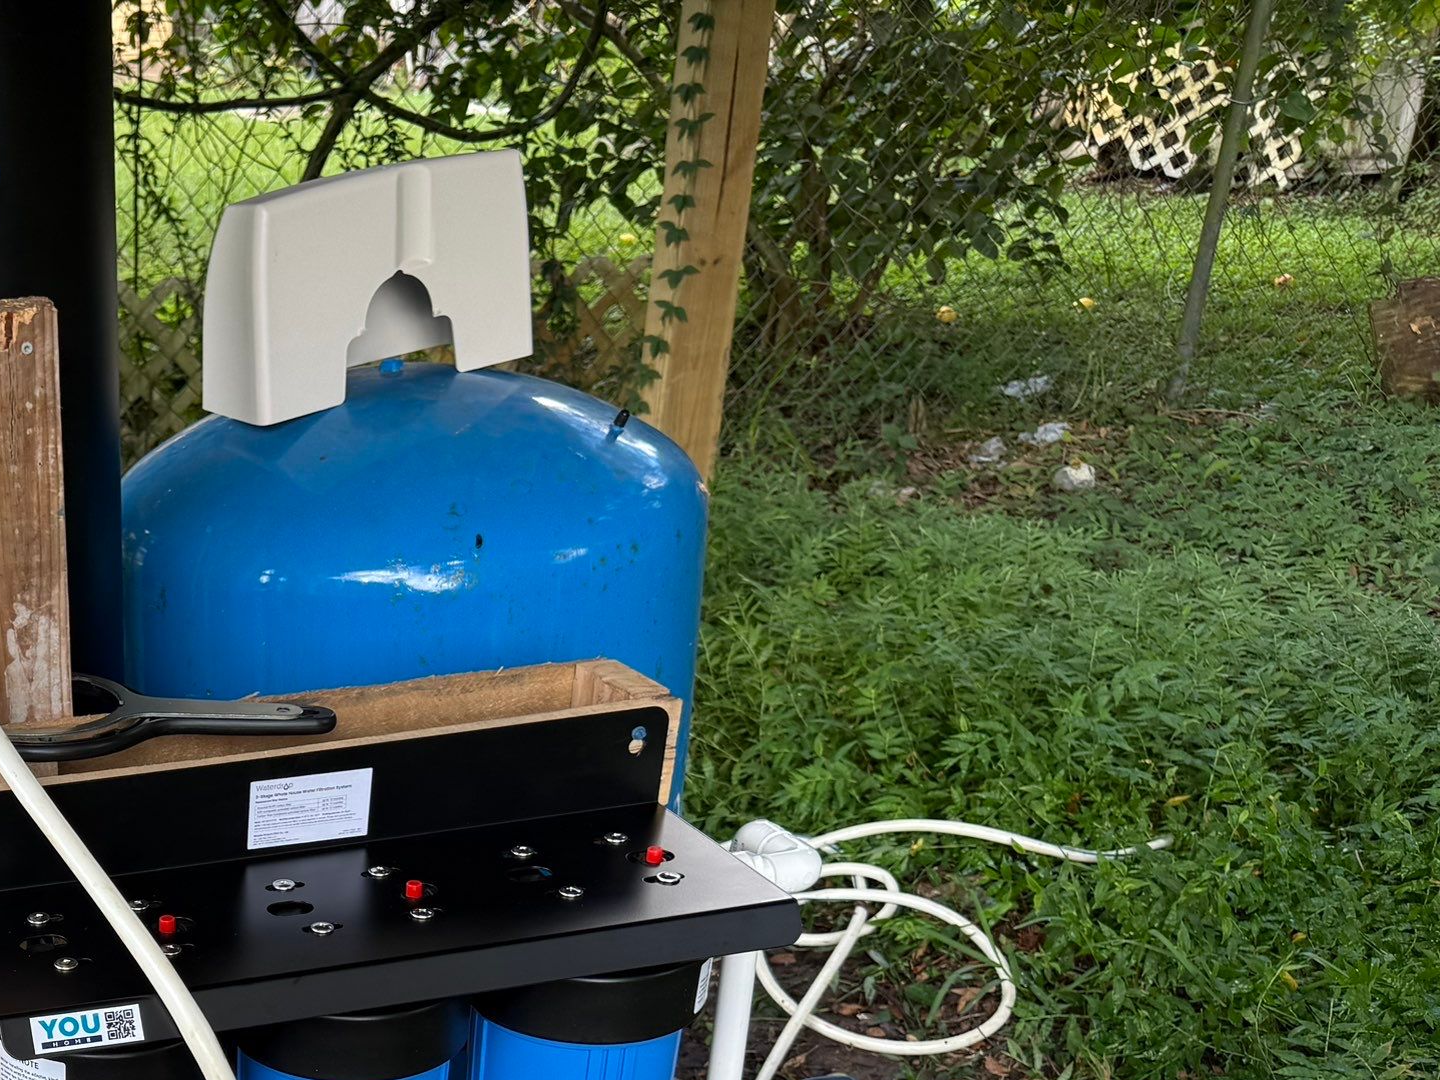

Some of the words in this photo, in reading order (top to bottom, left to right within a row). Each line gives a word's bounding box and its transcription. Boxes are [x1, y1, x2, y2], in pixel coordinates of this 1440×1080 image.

[256, 782, 294, 792] Waterdrop
[38, 1013, 101, 1039] YOU
[52, 1037, 92, 1047] HOME
[19, 1060, 39, 1070] OTE
